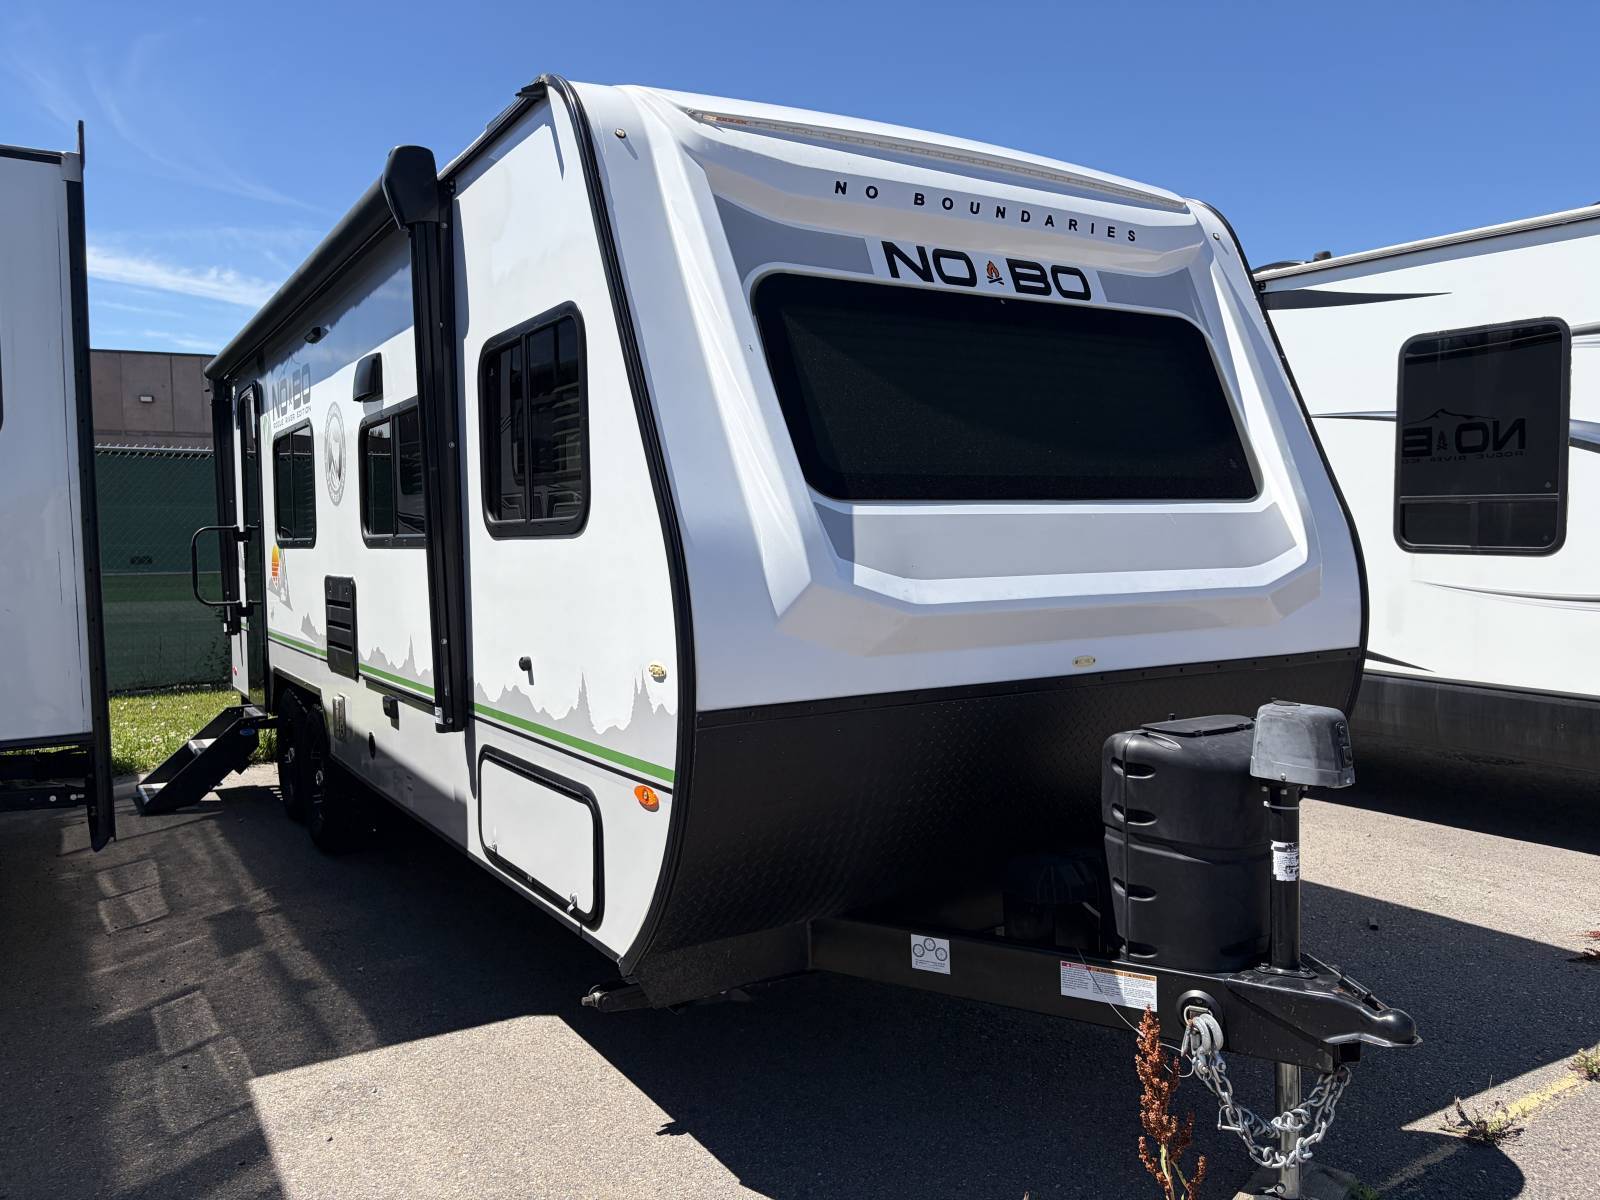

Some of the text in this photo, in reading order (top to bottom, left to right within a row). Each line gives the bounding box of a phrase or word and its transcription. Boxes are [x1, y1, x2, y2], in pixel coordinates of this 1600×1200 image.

[834, 180, 1136, 242] NO BOUNDARIES
[881, 240, 1092, 301] NO BO
